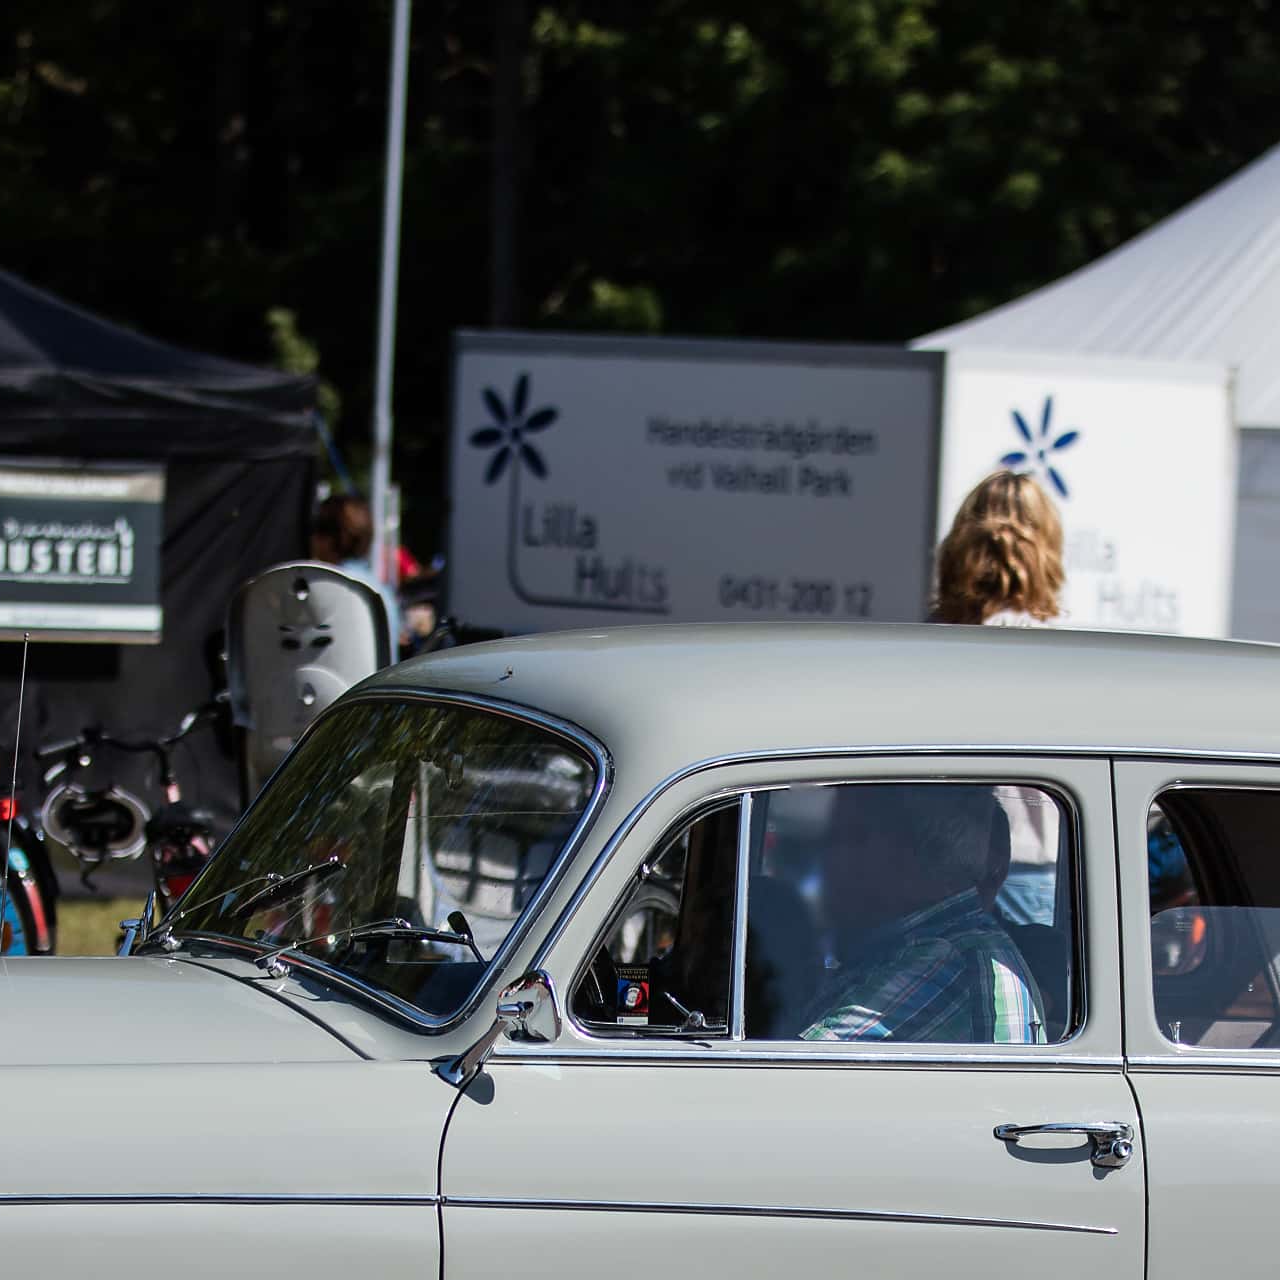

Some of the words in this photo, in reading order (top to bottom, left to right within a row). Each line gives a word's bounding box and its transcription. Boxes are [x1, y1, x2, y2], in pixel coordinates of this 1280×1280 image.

[667, 462, 705, 491] vid
[711, 463, 790, 494] Valhall
[798, 464, 852, 497] Park
[524, 505, 598, 549] Lilla
[576, 555, 669, 602] Hults
